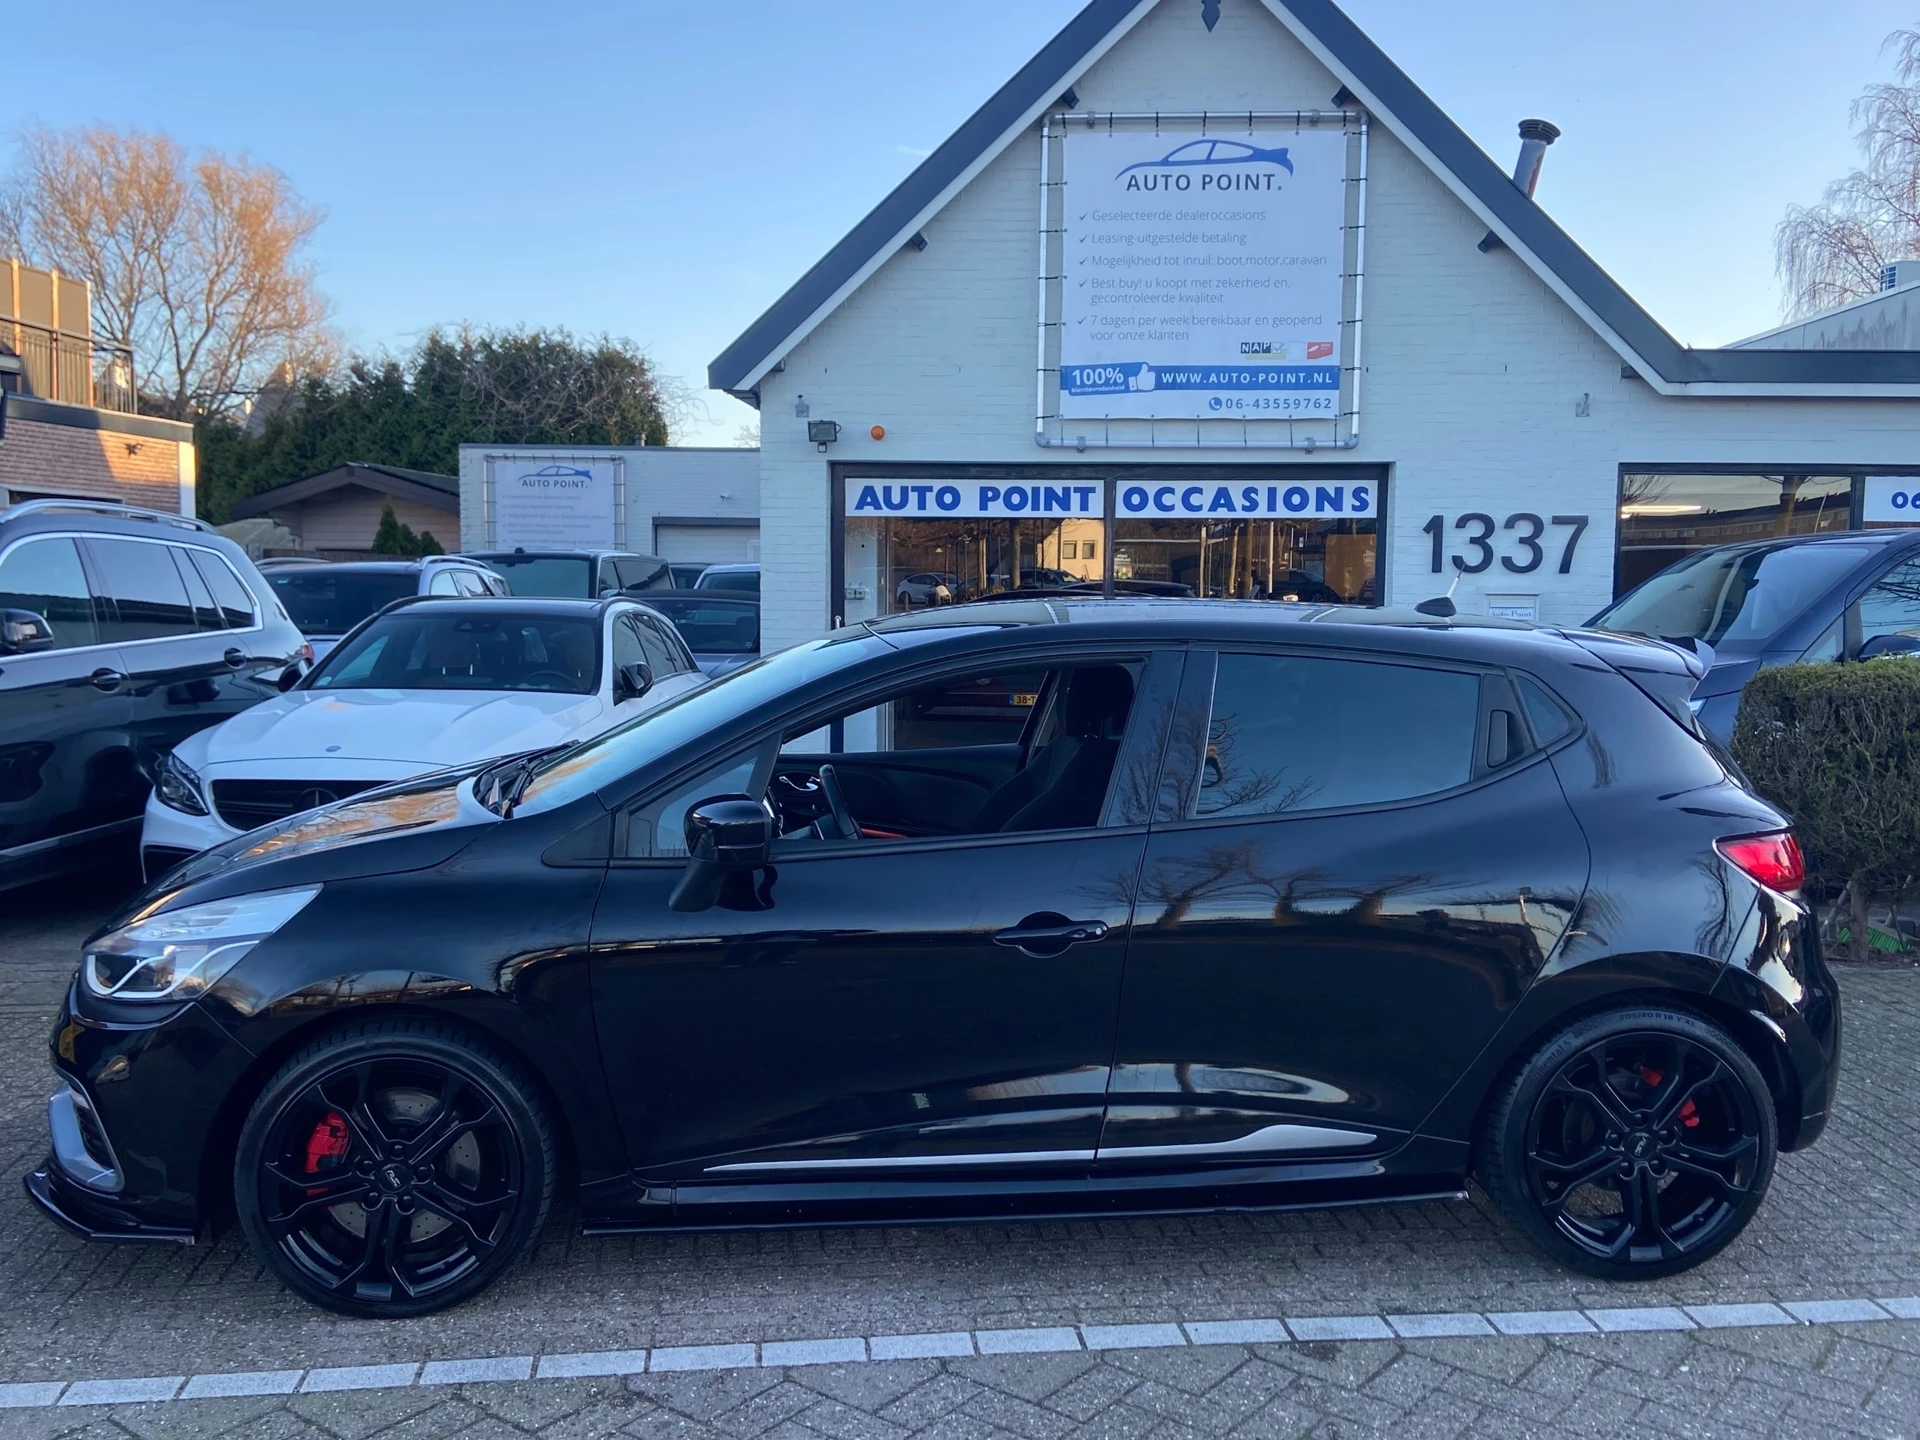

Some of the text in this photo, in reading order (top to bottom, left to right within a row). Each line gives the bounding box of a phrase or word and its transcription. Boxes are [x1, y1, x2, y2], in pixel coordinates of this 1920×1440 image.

[1125, 173, 1282, 191] AUTO POINT.
[1091, 209, 1266, 221] Geselecteerde dealeroccasions
[1092, 232, 1247, 246] Leasing-uitgestelde betaling
[1092, 255, 1161, 268] Mogelijkheid
[1164, 256, 1180, 266] tot
[1217, 254, 1327, 267] boot,motor,caravan
[1091, 276, 1290, 292] Best buy! u koopt met zekerheid en,
[1091, 292, 1224, 305] gecontroleerde kwaliteit
[1091, 314, 1322, 329] 7 dagen per week bereikbaar en geopend
[1090, 329, 1189, 341] voor onze klanten
[1241, 342, 1271, 354] NAP
[1072, 367, 1124, 385] 100%
[1162, 372, 1332, 384] WWW.AUTO-POINT.NL
[1225, 398, 1332, 409] 06-43559762
[522, 479, 550, 488] AUTO
[855, 486, 1096, 512] AUTO POINT
[1123, 486, 1370, 512] OCCASIONS
[1422, 513, 1589, 574] 1337
